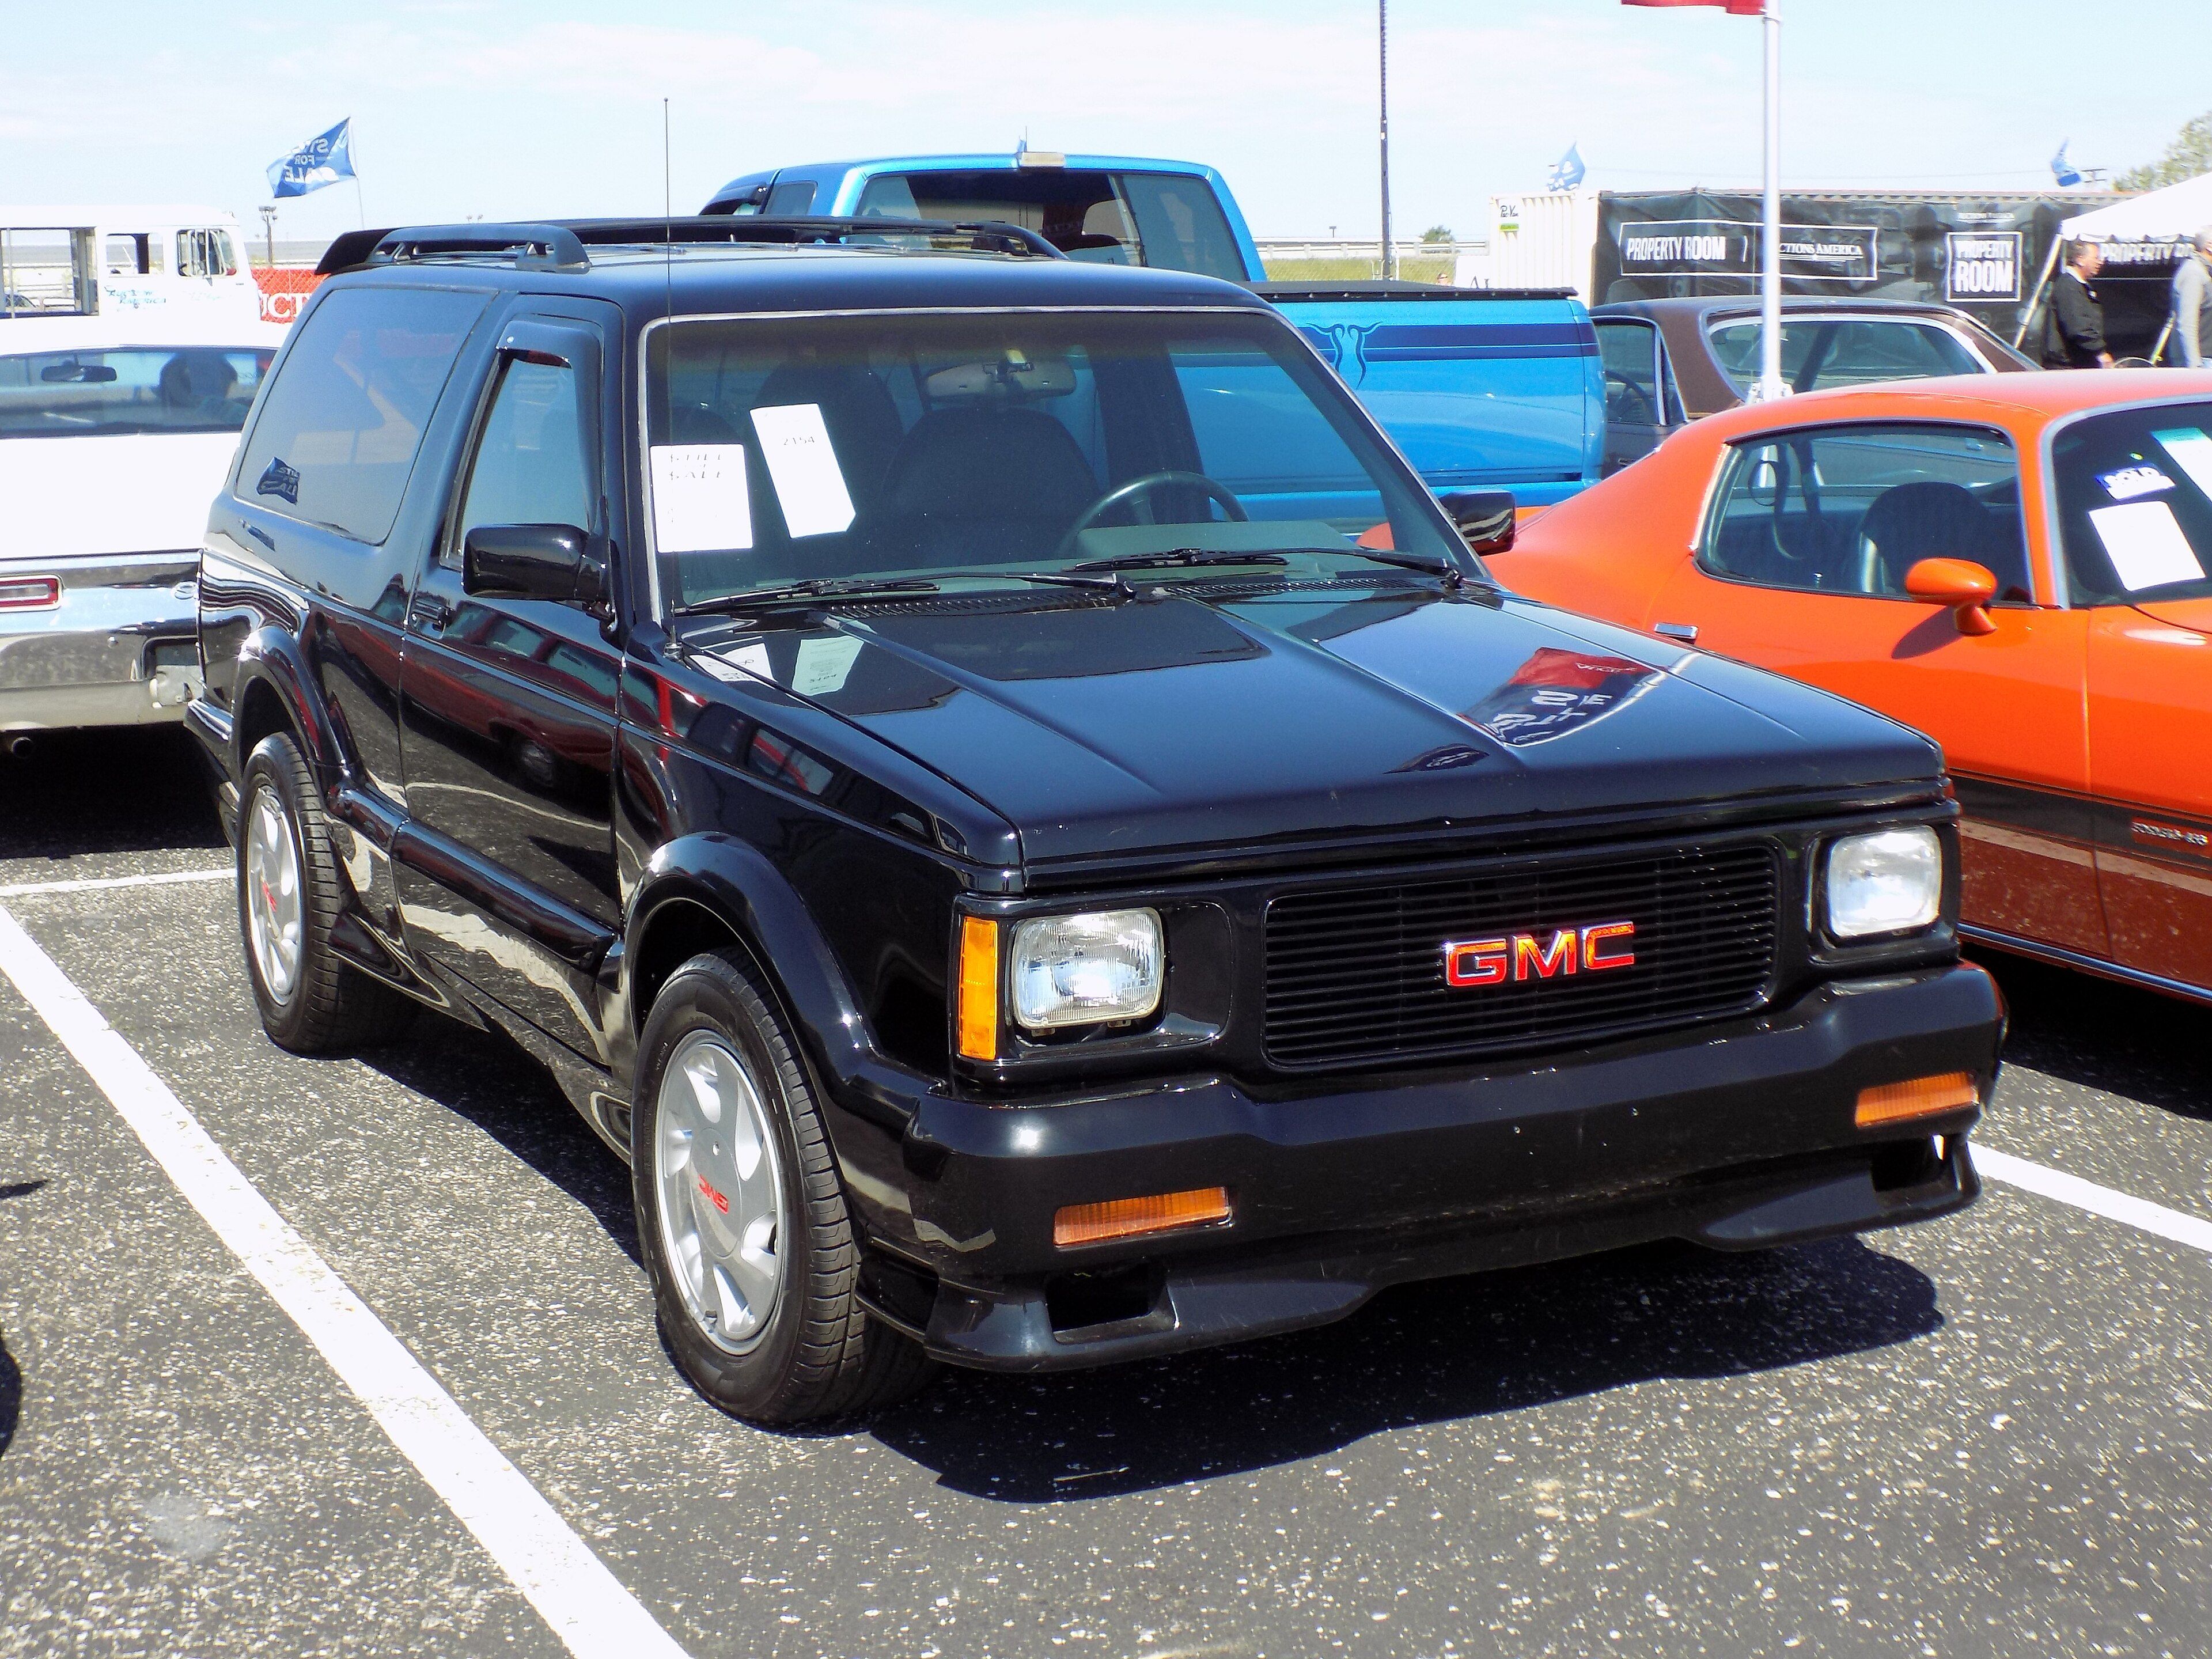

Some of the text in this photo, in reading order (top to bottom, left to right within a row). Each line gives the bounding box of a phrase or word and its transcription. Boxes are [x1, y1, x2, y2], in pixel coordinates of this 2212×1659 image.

[1626, 235, 1727, 260] PROPERTY ROOM
[1816, 243, 1863, 255] AMERICA
[1953, 240, 2014, 259] PROPERTY
[1953, 259, 2014, 293] ROOM
[1444, 921, 1635, 987] GMC
